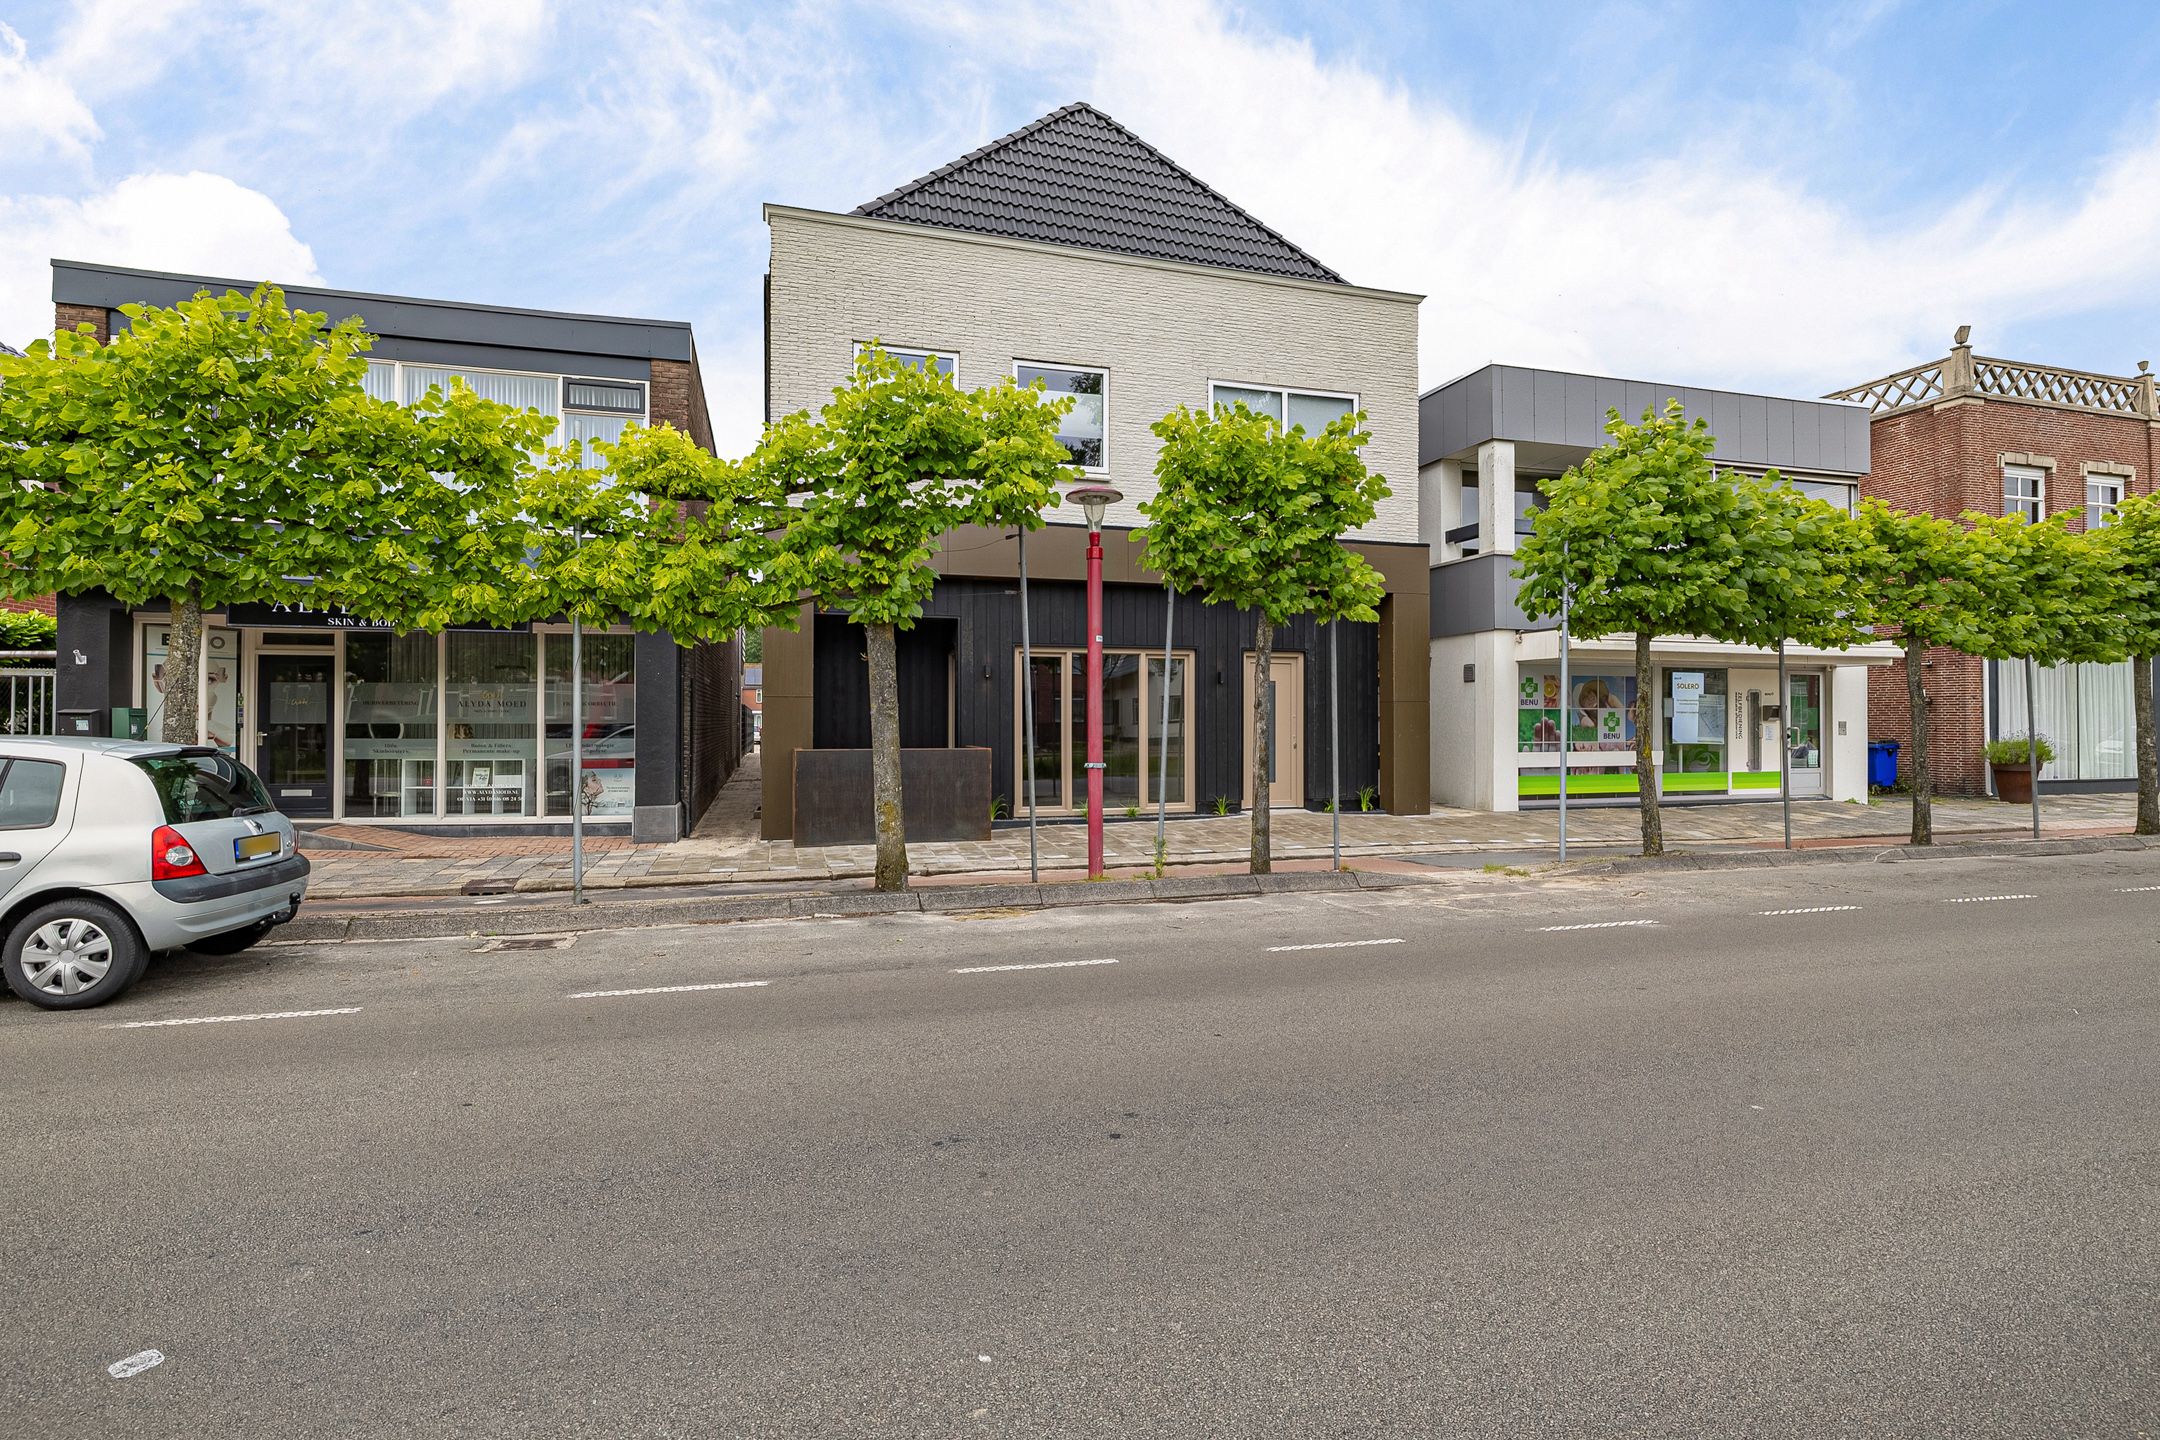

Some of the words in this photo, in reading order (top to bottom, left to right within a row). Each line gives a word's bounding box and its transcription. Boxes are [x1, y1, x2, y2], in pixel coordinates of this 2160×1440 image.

[327, 617, 354, 626] SKIN
[359, 618, 367, 627] &
[371, 619, 402, 627] BOD
[1676, 682, 1700, 690] SOLERO
[457, 700, 492, 708] ALYDA
[497, 700, 527, 708] MOED
[1603, 732, 1621, 740] BENU
